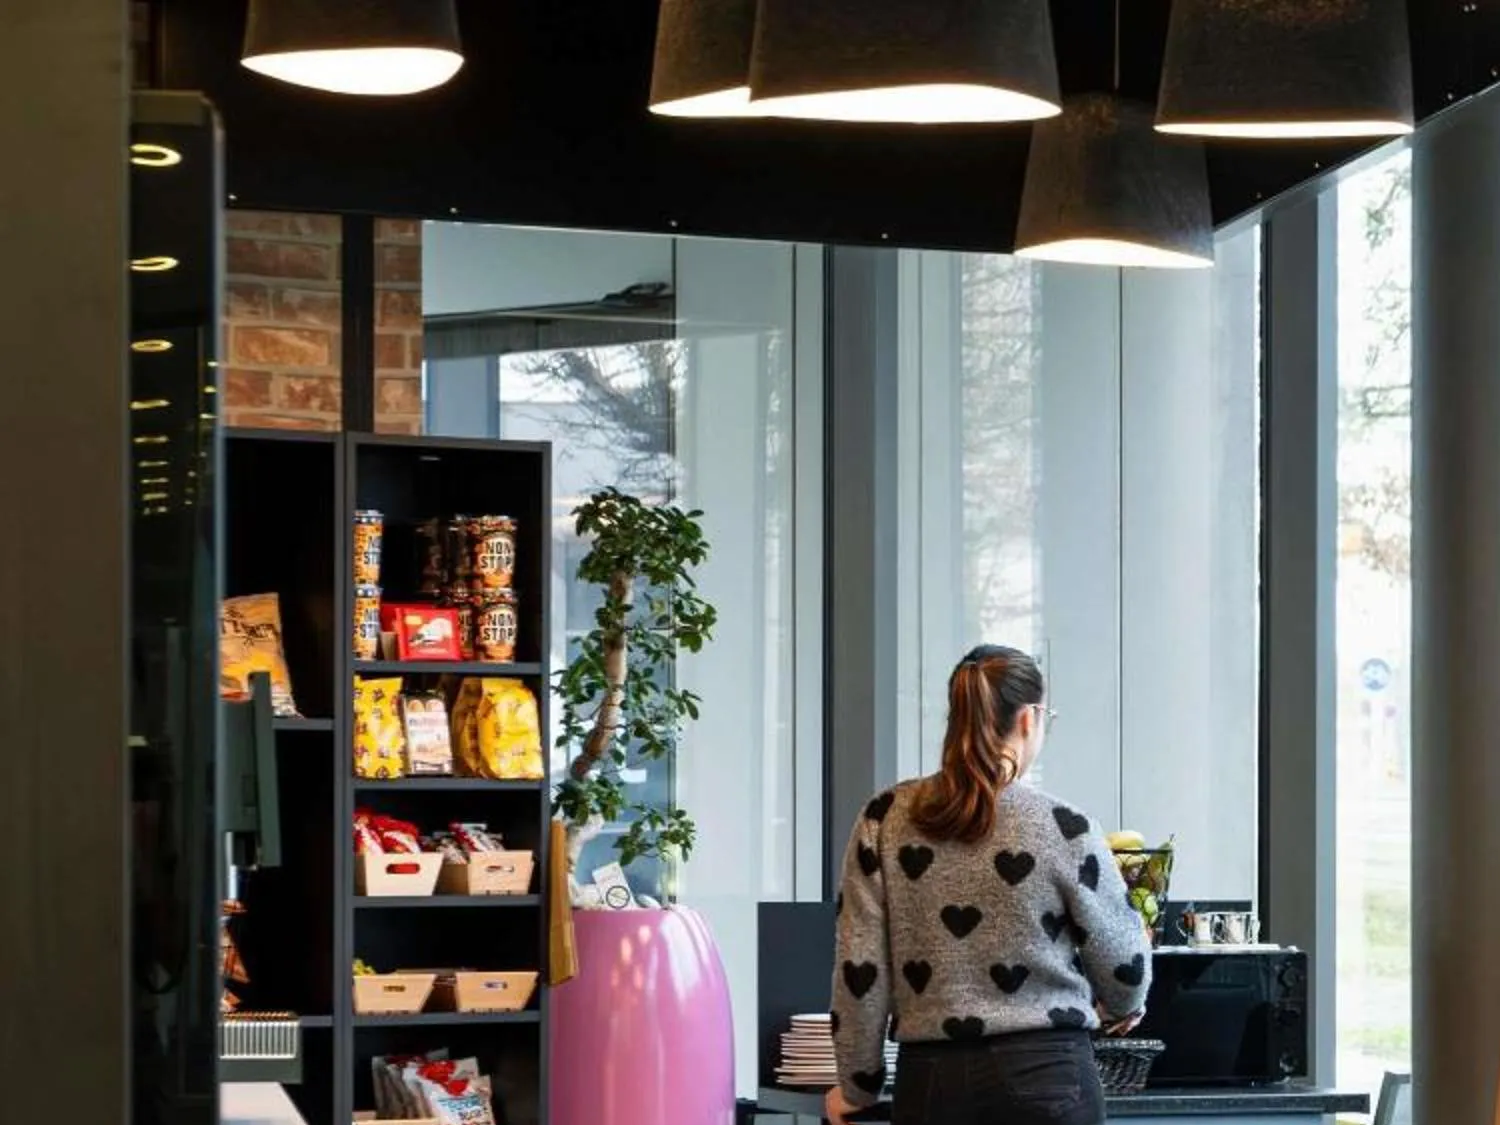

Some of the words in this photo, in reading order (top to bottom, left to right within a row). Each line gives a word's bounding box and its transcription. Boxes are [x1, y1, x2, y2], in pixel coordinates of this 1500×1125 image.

[486, 541, 511, 554] NON
[480, 555, 513, 569] STOP
[487, 613, 513, 626] NON
[483, 627, 514, 641] STOP
